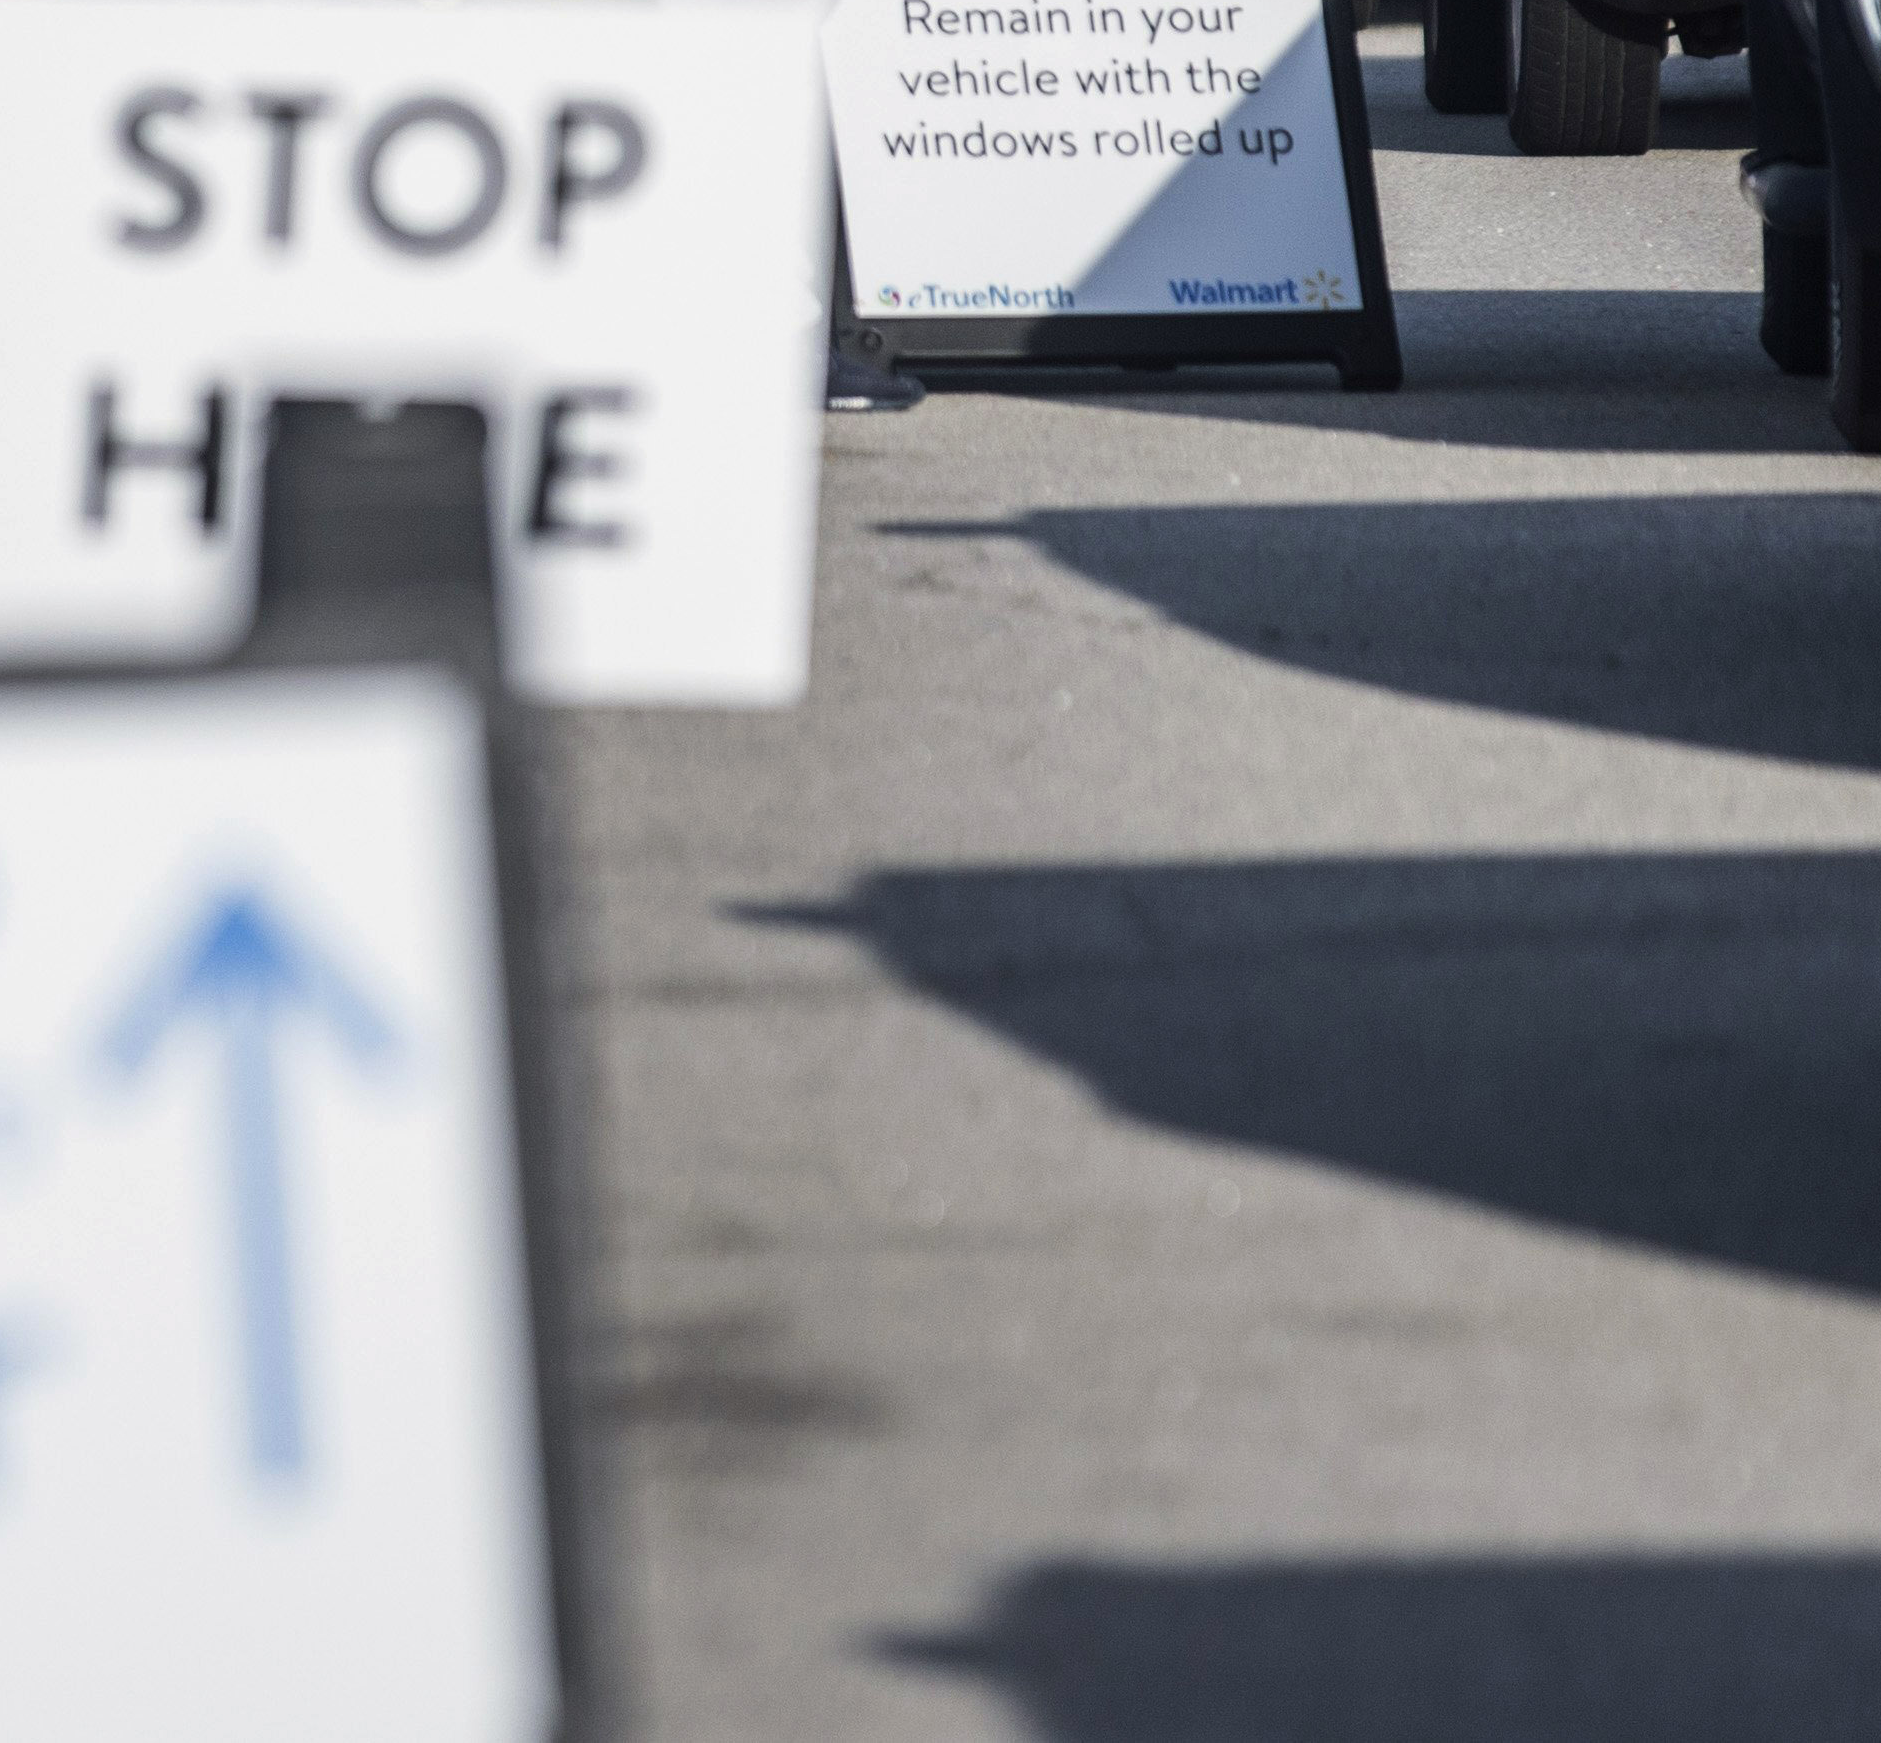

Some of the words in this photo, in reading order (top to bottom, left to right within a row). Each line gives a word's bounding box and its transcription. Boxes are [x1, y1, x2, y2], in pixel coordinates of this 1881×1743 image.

[1139, 3, 1243, 46] your
[899, 58, 1060, 97] vehicle
[1077, 58, 1172, 96] with
[1186, 58, 1262, 96] the
[883, 122, 1079, 159] windows
[1093, 122, 1225, 157] rolled
[1239, 125, 1296, 166] up
[101, 82, 655, 258] STOP
[907, 283, 1076, 311] eTrueNorth
[1168, 277, 1300, 308] Walmart
[75, 371, 644, 547] HE
